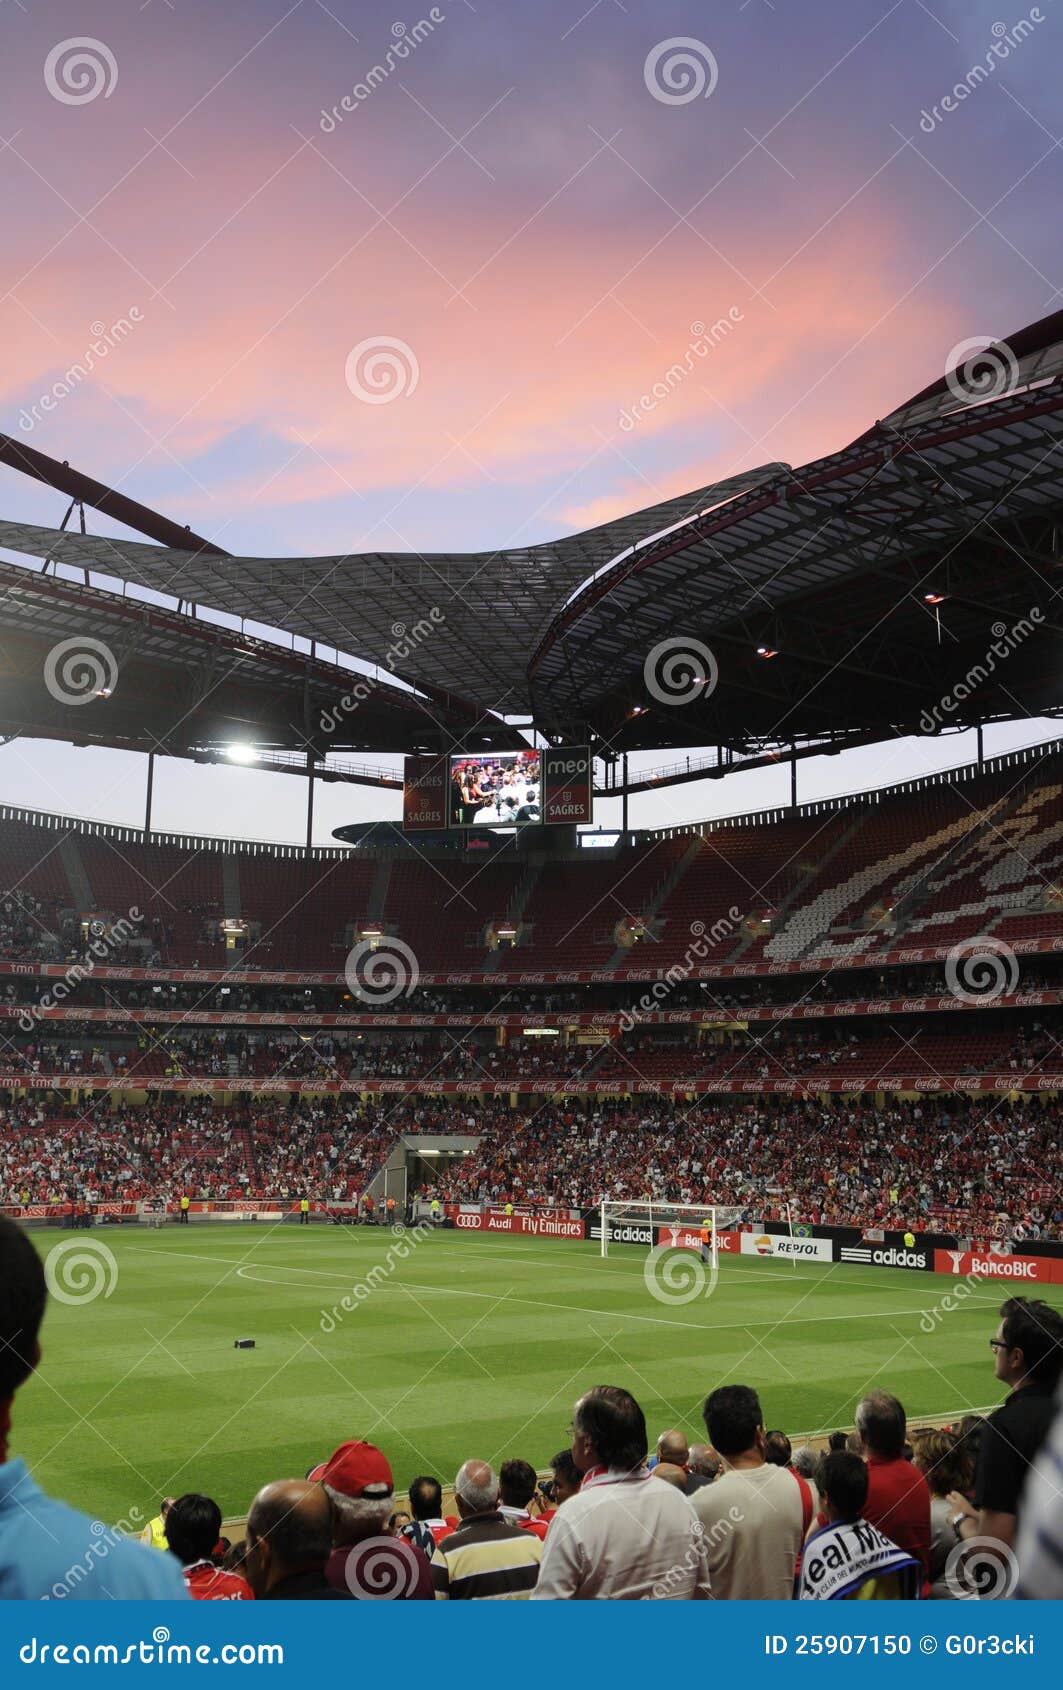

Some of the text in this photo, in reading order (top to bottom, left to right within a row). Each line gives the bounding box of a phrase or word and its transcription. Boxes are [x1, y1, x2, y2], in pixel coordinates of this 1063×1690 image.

[547, 758, 588, 775] meo
[407, 811, 441, 823] SAGRES
[550, 804, 585, 816] SAGRES
[0, 1078, 20, 1088] mn
[488, 1217, 512, 1229] Audi
[522, 1218, 582, 1236] Fly Emirates
[614, 1226, 653, 1243] adidas
[685, 1233, 731, 1250] BanBIC
[778, 1241, 819, 1255] REPSOL
[873, 1249, 926, 1268] adidas
[971, 1257, 1037, 1278] BancoBIC
